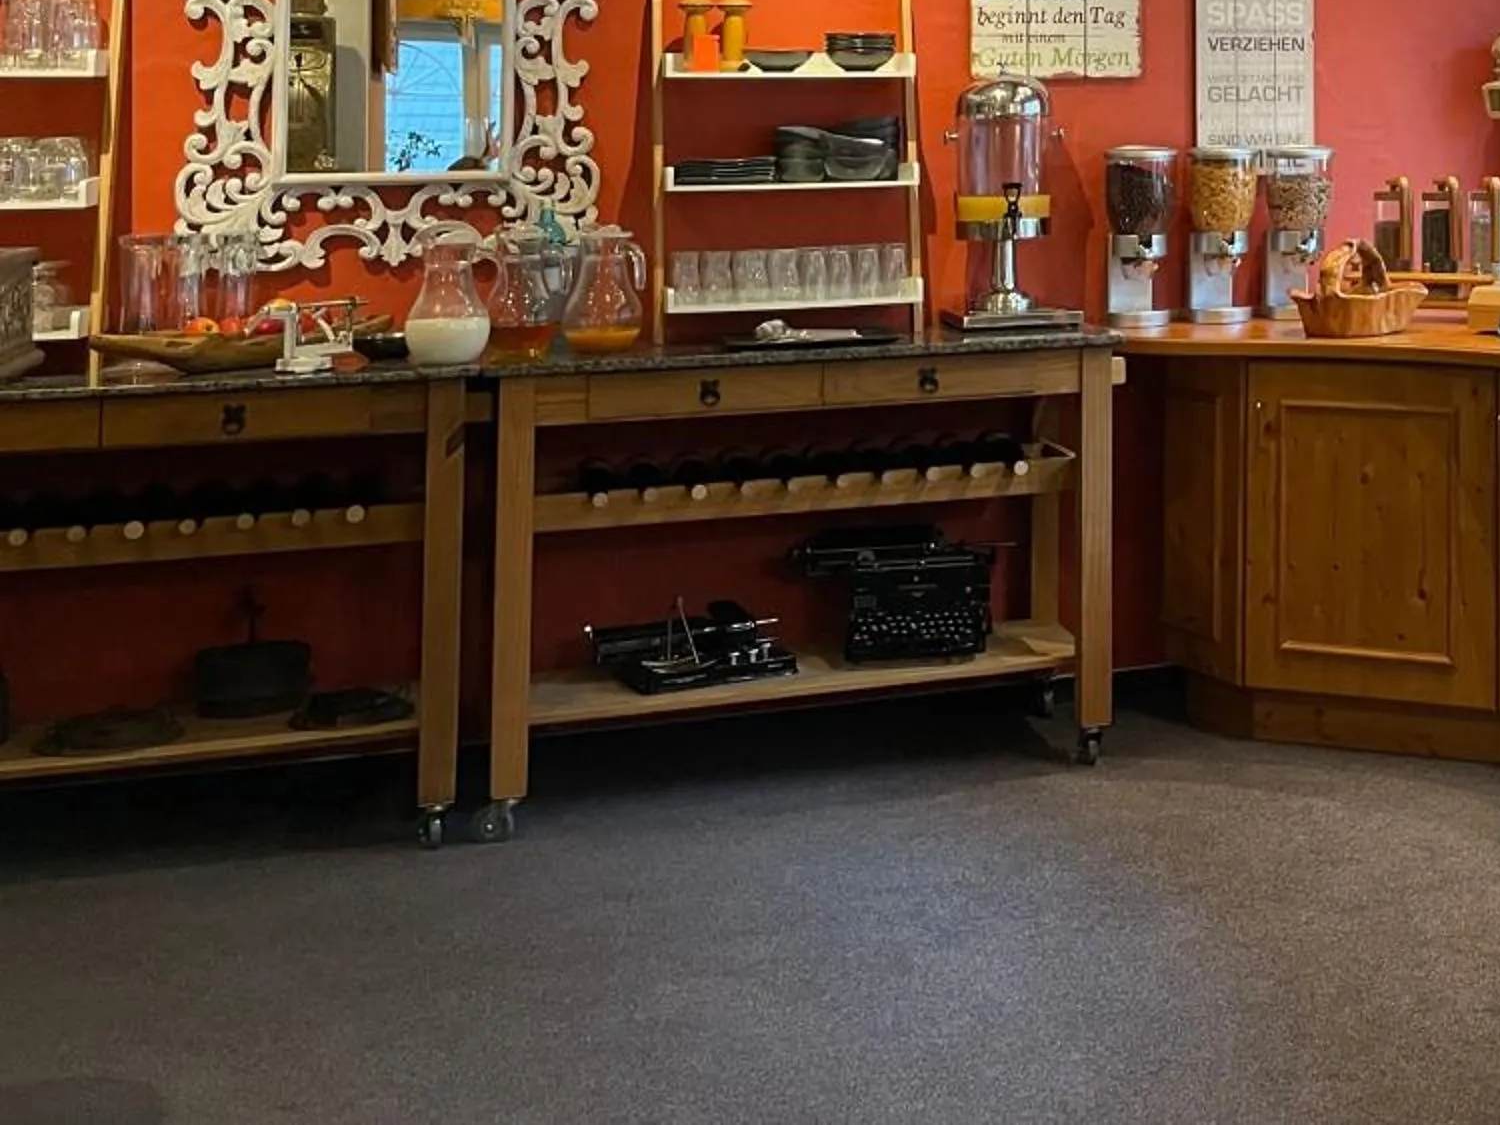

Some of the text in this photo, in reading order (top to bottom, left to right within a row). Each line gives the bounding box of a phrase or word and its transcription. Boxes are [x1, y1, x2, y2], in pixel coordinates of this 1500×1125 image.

[977, 6, 1126, 28] beginnt den Tag
[1207, 1, 1304, 26] SPASS
[1001, 31, 1065, 44] mit einem
[1208, 37, 1305, 52] VERZIEHEN
[977, 47, 1131, 71] Guten Morgen
[1208, 85, 1304, 102] GELACHT
